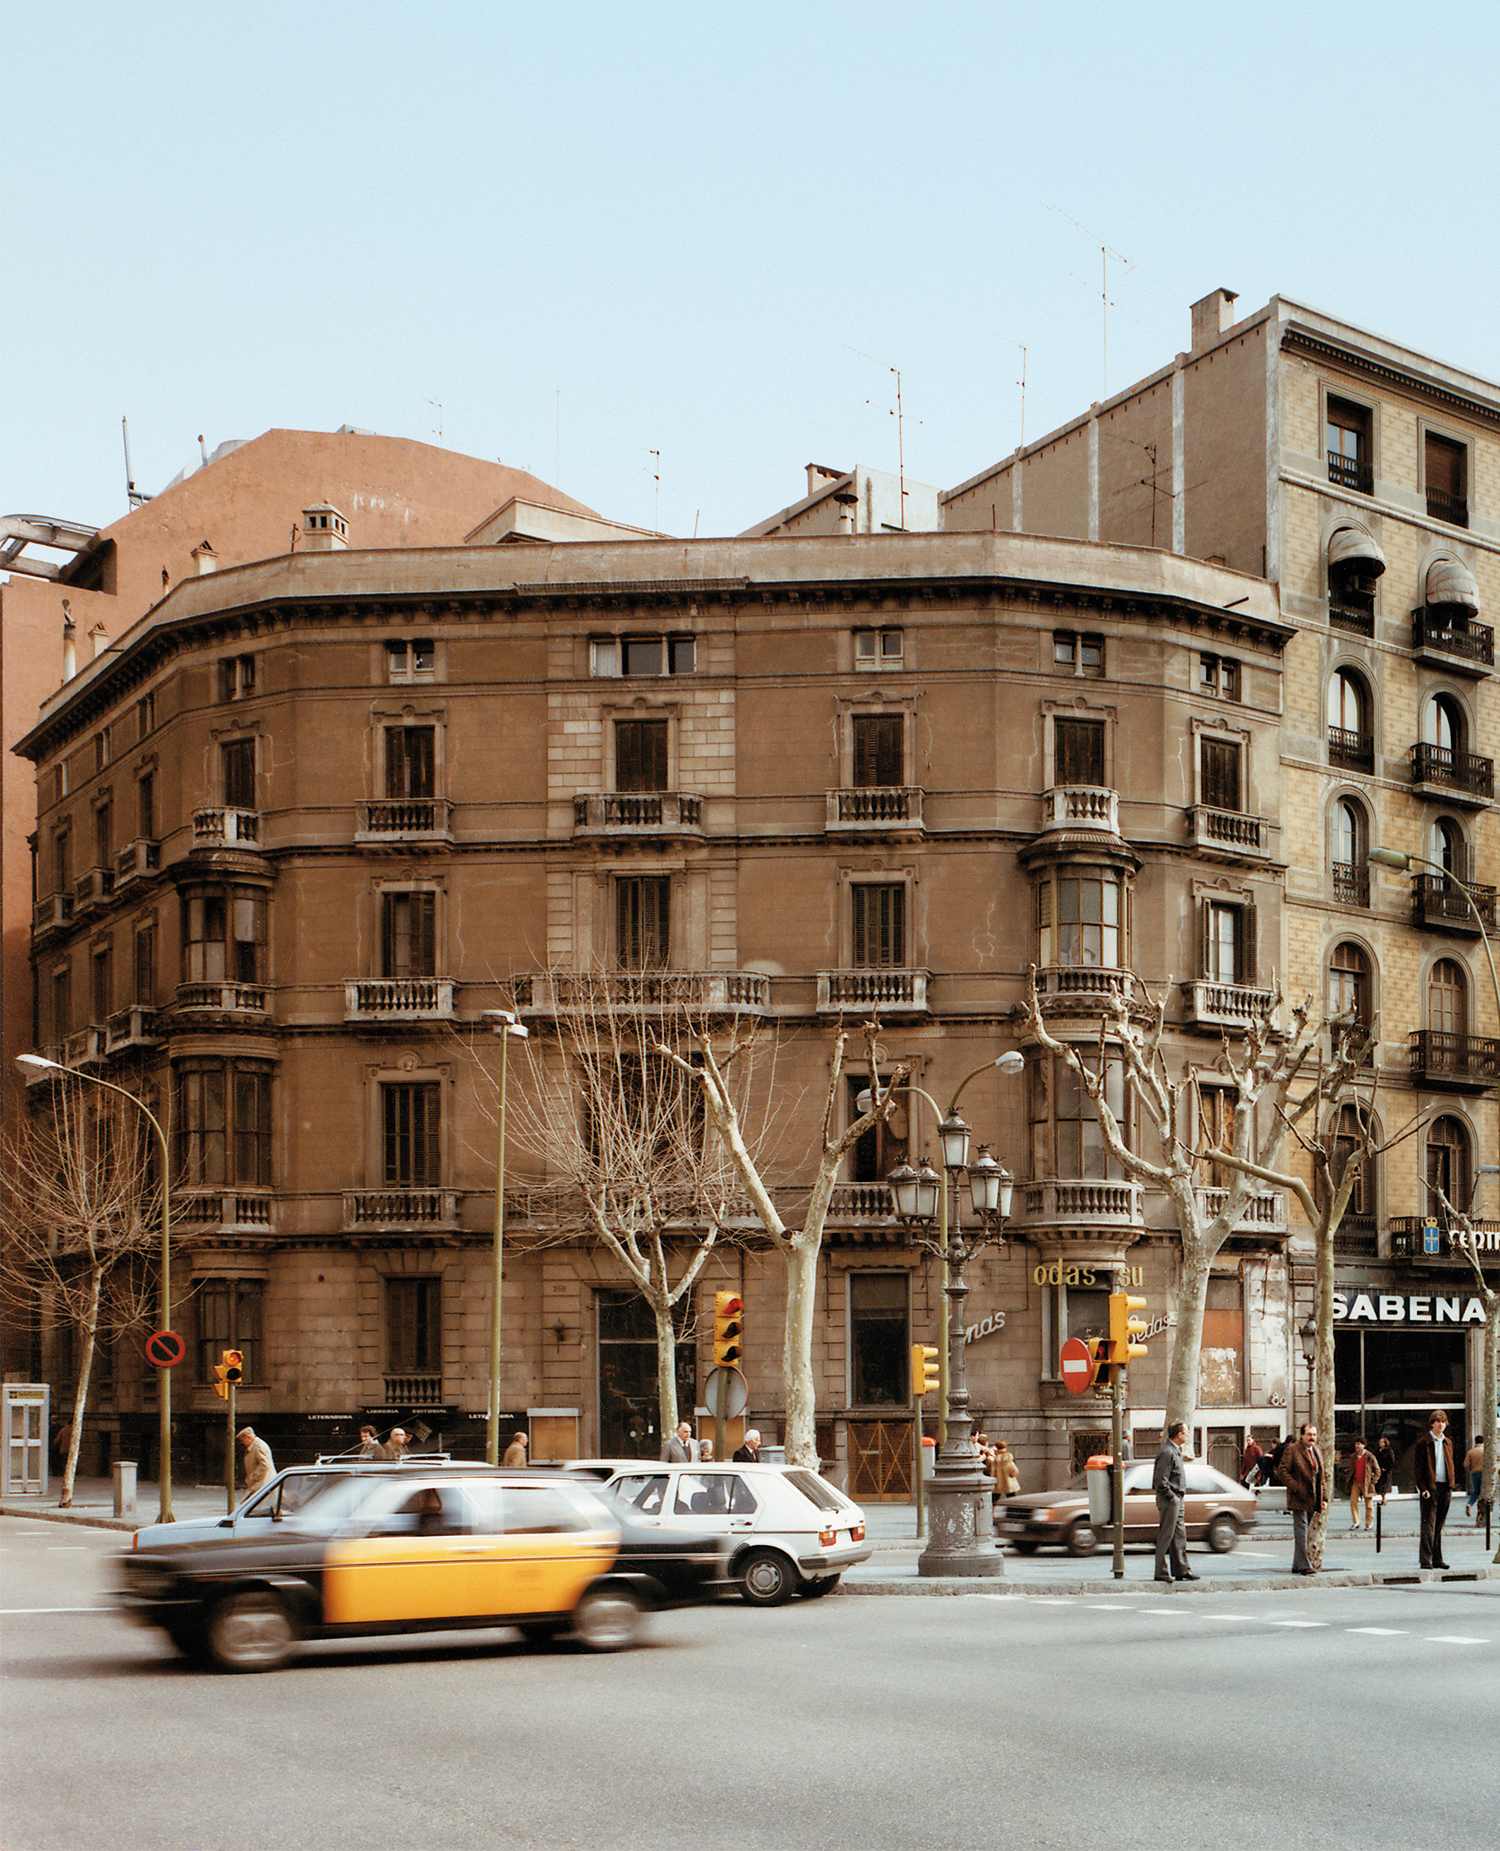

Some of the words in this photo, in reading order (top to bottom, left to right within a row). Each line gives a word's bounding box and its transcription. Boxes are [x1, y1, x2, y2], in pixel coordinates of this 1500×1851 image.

[1034, 1258, 1096, 1285] odas
[1118, 1266, 1143, 1287] su
[1333, 1293, 1486, 1322] SABENA
